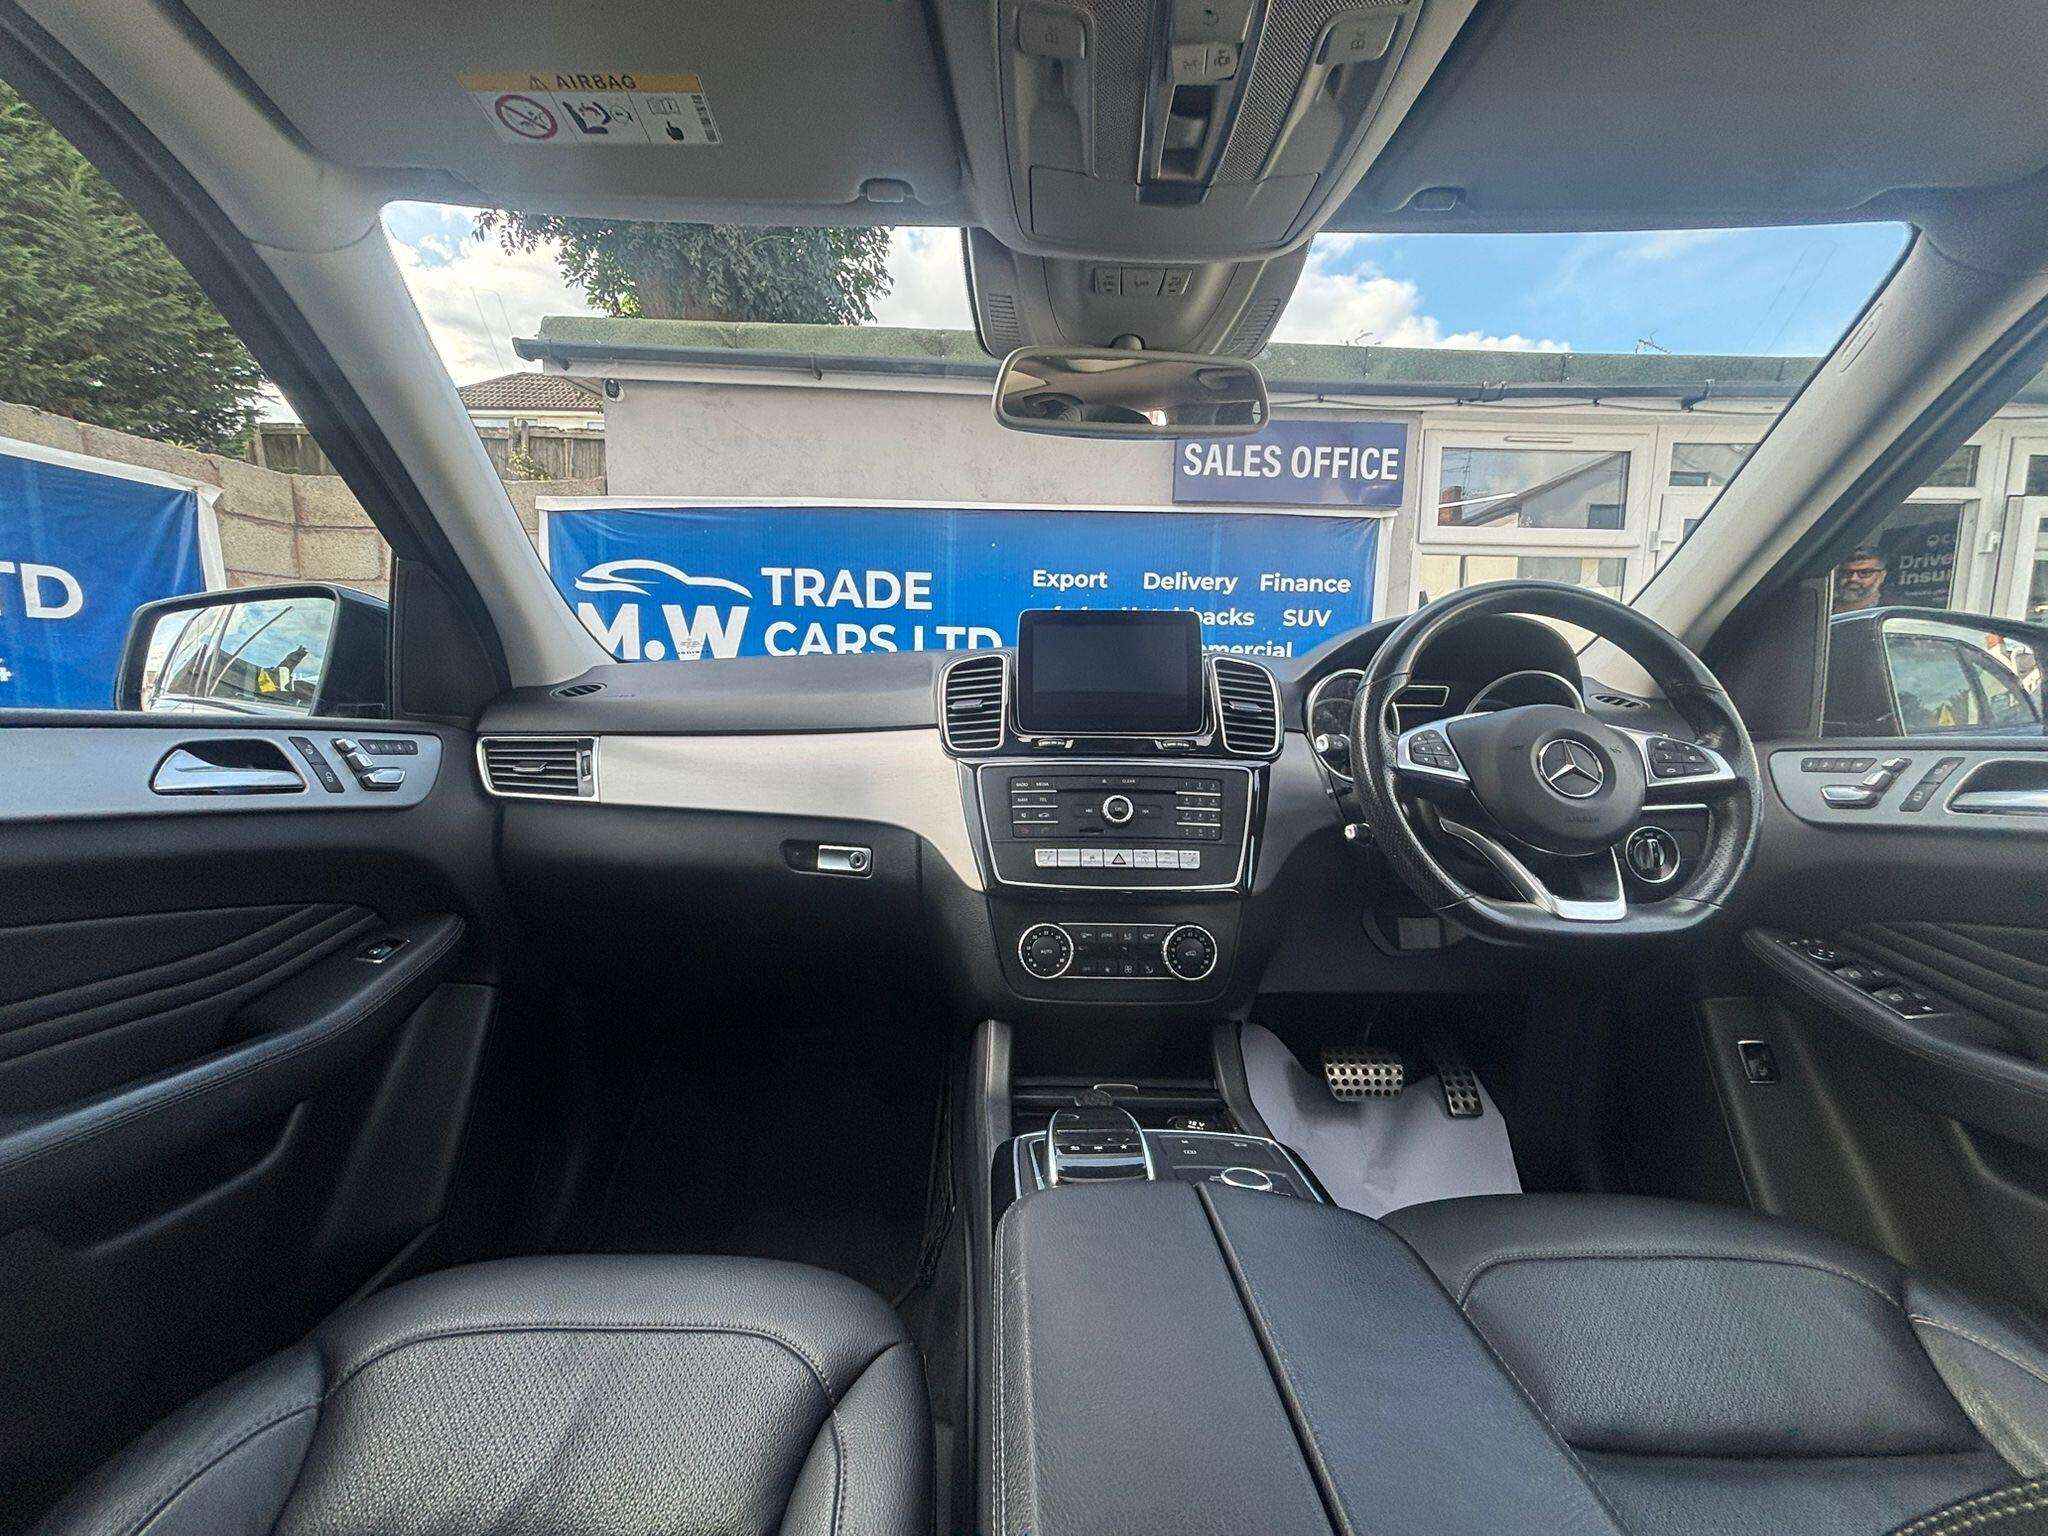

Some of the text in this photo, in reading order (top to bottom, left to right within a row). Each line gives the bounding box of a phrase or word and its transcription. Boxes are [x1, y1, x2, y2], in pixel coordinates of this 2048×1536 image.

[556, 74, 636, 90] AIRBAG
[1182, 443, 1399, 481] SALES OFFICE
[761, 567, 933, 611] TRADE
[1032, 569, 1351, 595] Export Delivery Finance
[1282, 609, 1332, 627] SUV
[764, 621, 898, 657] CARS
